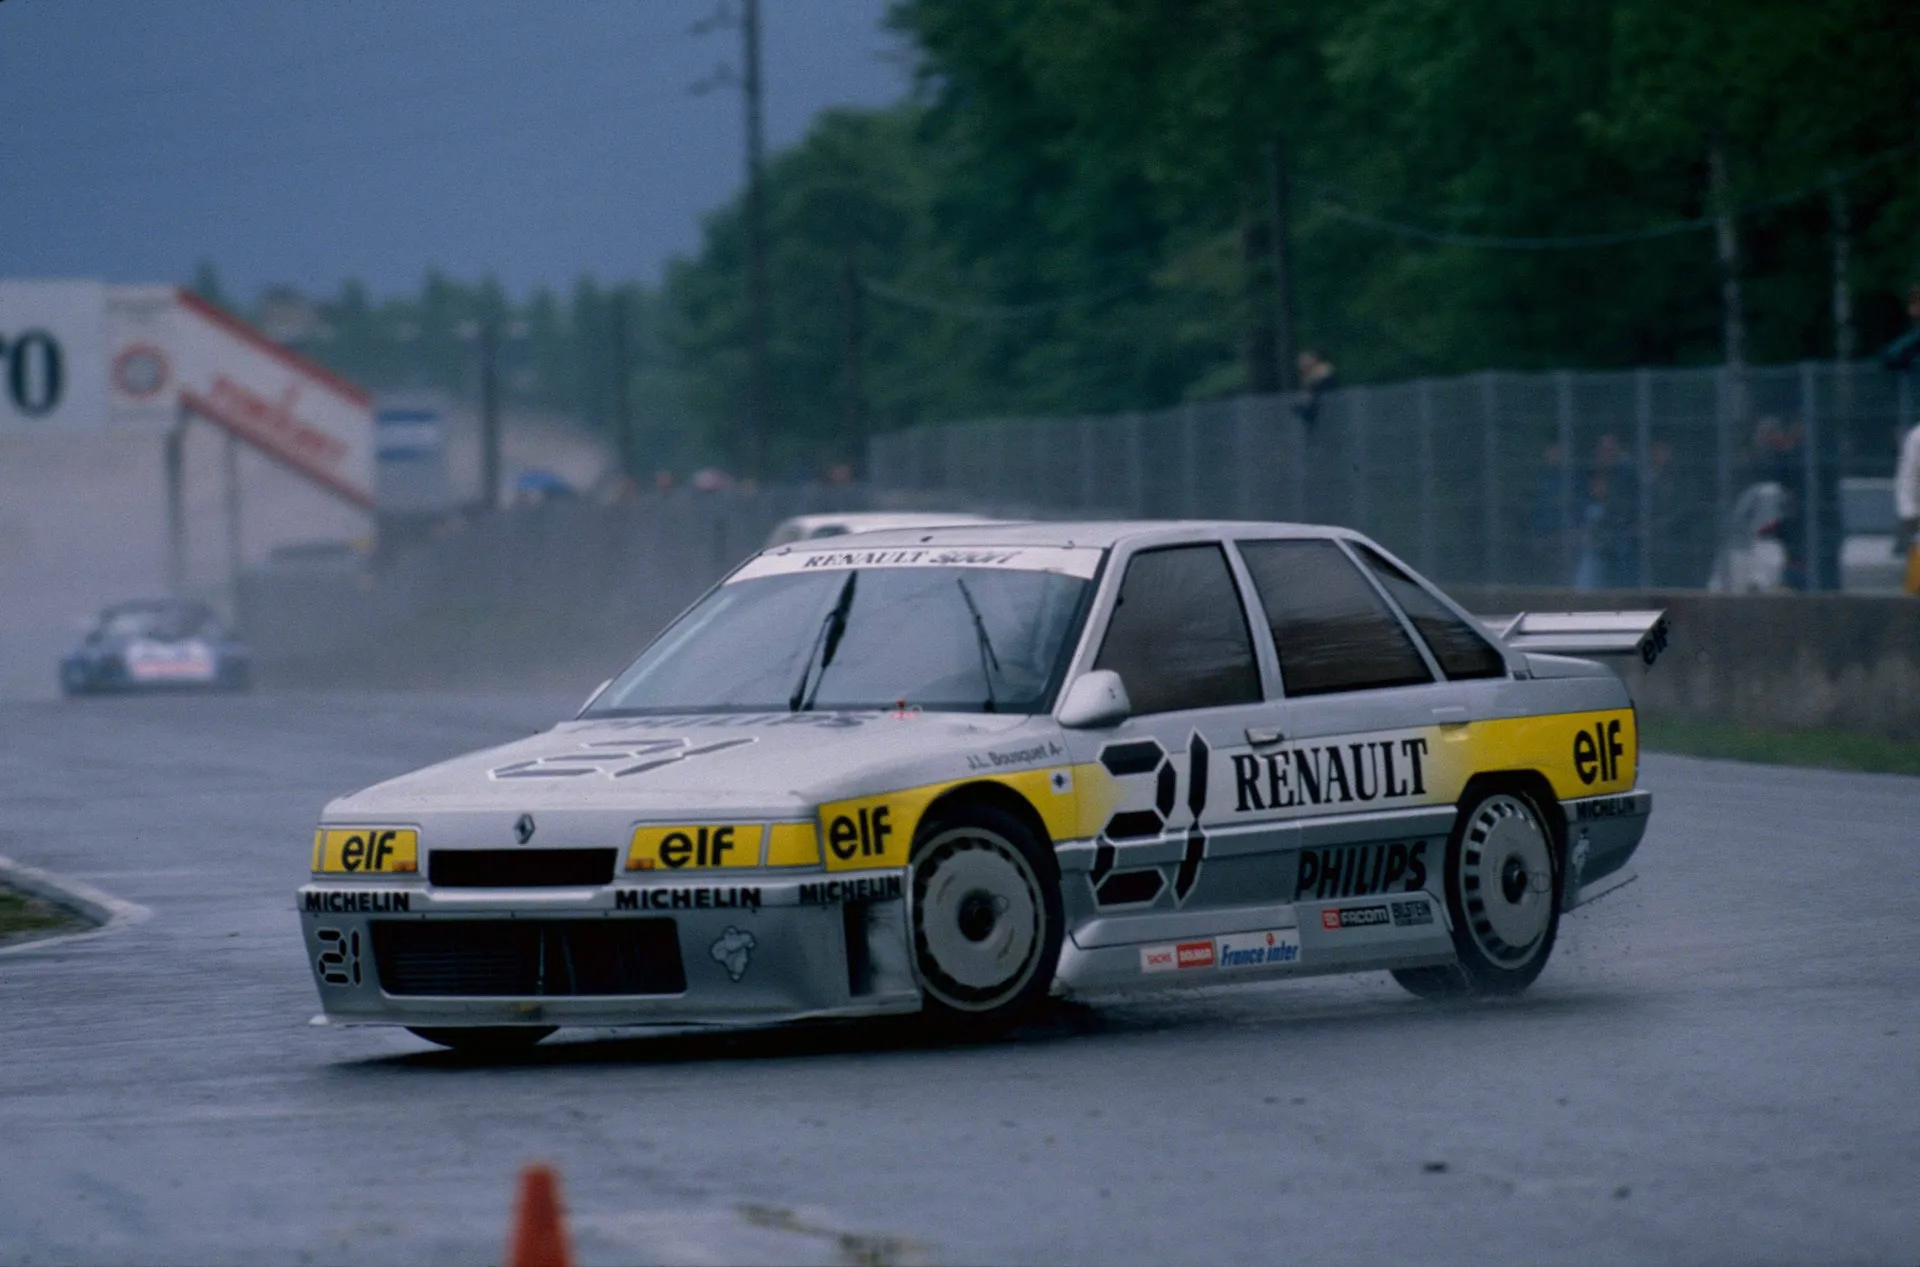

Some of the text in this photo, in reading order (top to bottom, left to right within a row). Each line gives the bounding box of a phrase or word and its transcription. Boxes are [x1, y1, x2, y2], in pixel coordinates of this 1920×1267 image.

[804, 549, 929, 568] RENAULT
[1642, 618, 1668, 666] elf
[487, 736, 760, 780] 21
[1573, 719, 1623, 785] elf
[1231, 738, 1428, 812] RENAULT
[1086, 728, 1211, 908] 21
[1576, 797, 1637, 819] MICHELIN
[341, 831, 397, 871] elf
[658, 826, 734, 868] elf
[829, 806, 892, 860] elf
[798, 876, 901, 904] MICHELIN
[1295, 841, 1428, 900] PHILIPS
[305, 891, 409, 912] MICHELIN
[614, 887, 762, 910] MICHELIN
[315, 928, 362, 986] 21
[1221, 935, 1299, 966] France inter
